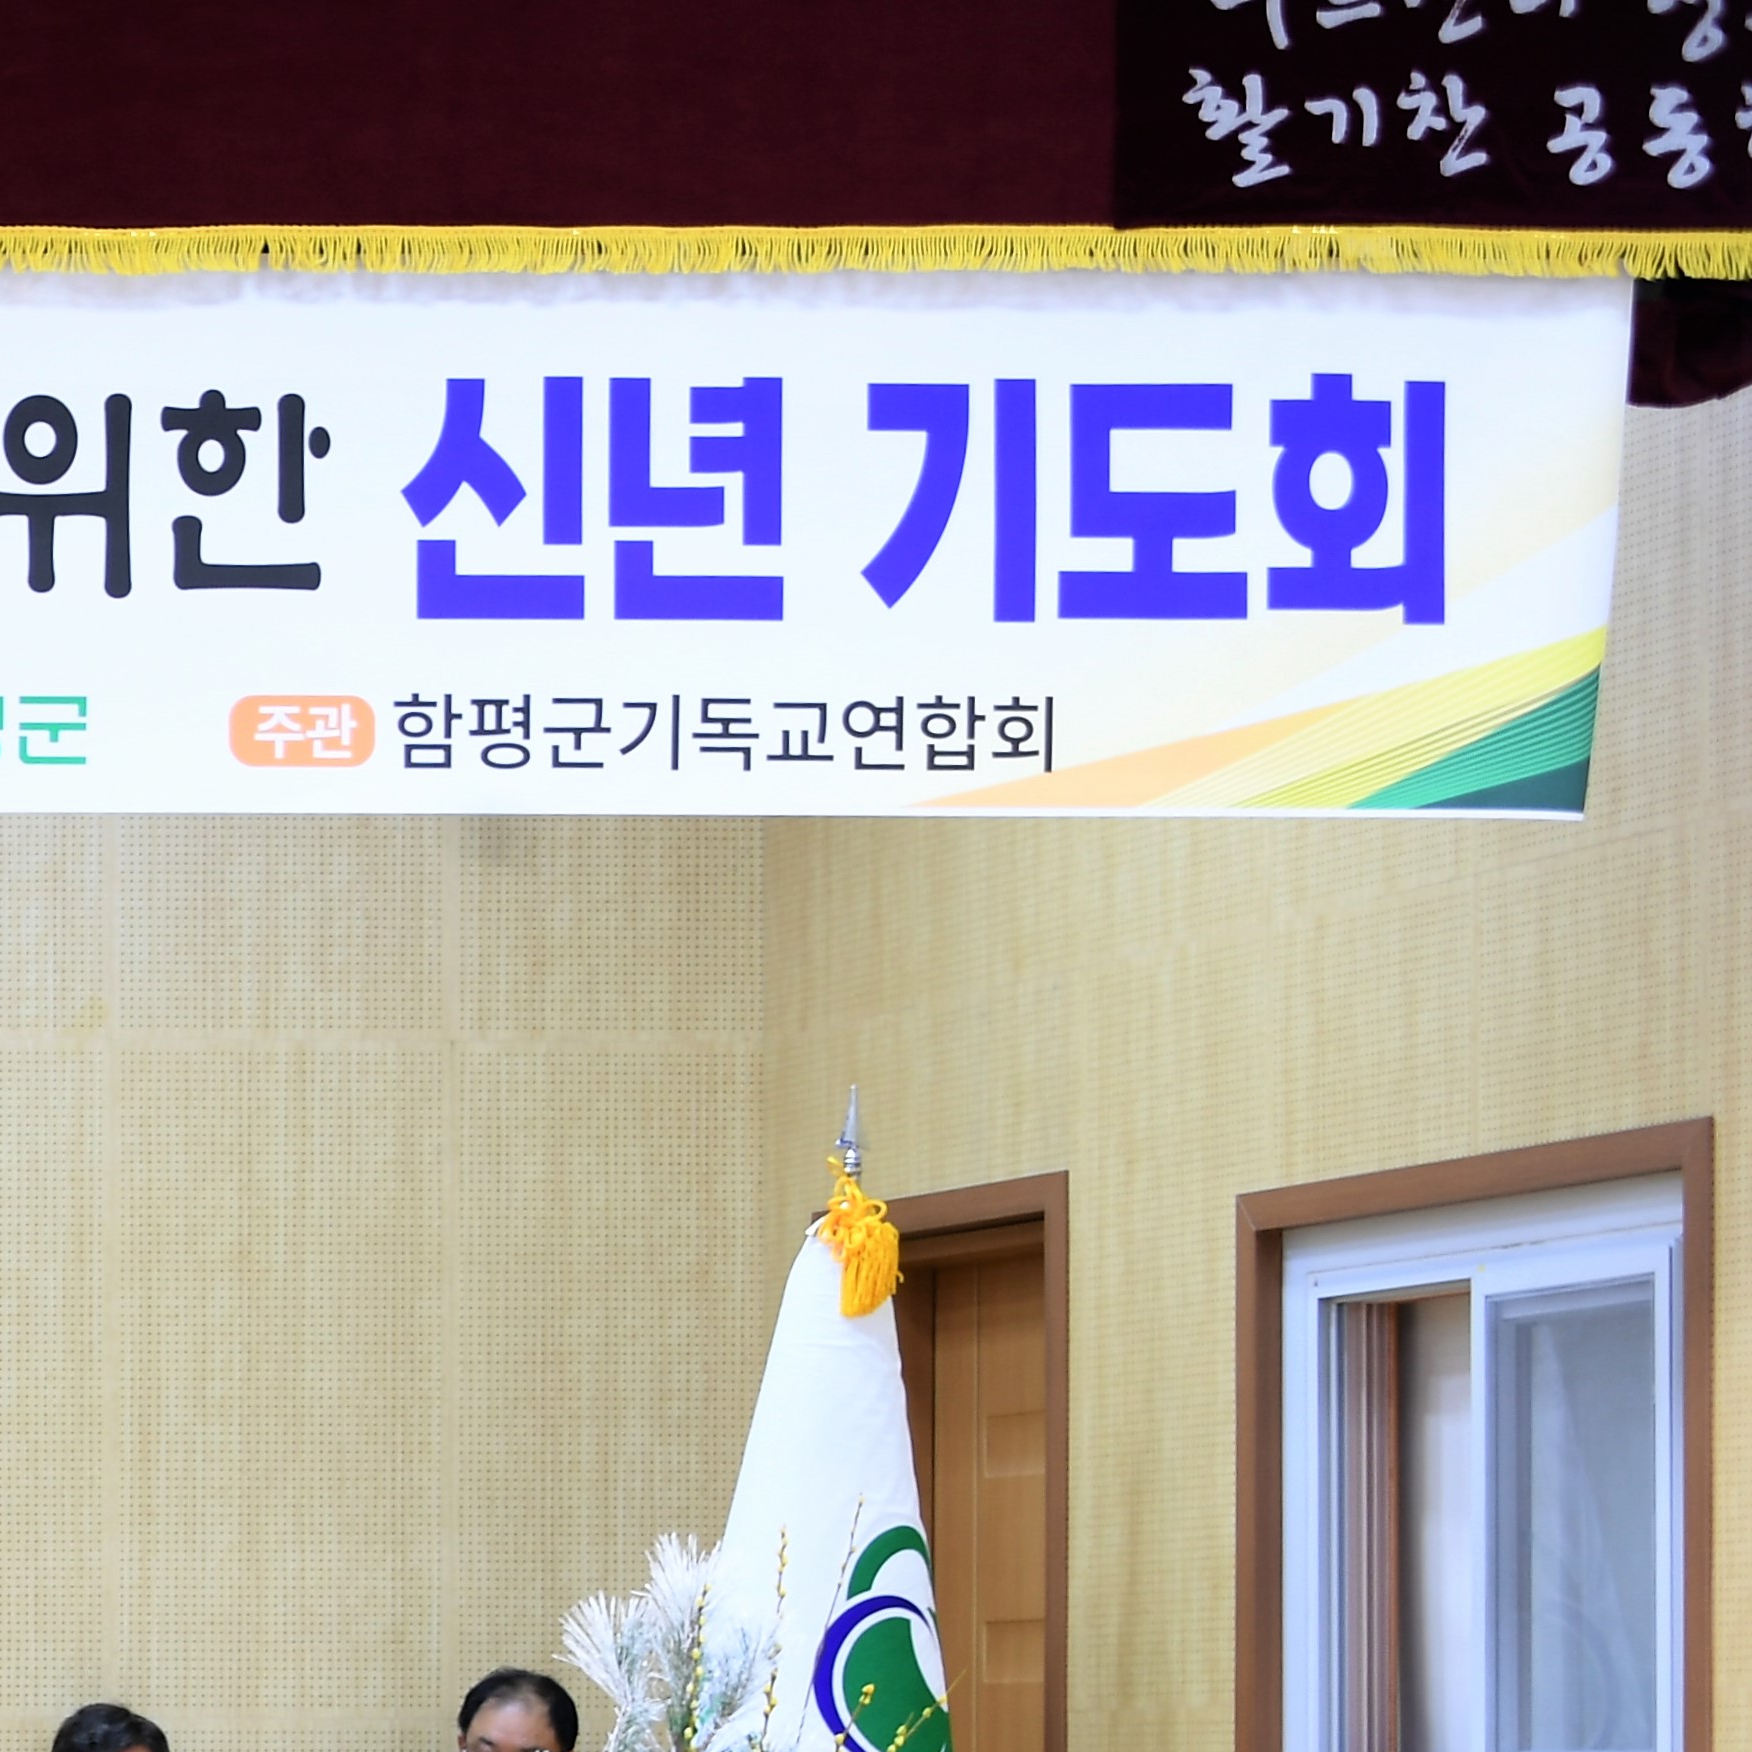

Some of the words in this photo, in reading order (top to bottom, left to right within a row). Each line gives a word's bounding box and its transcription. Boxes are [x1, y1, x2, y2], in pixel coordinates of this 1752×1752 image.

[1182, 68, 1489, 188] 활기찬
[1546, 84, 1752, 189] 공동
[401, 376, 784, 621] 신년
[861, 373, 1446, 625] 기도회
[252, 702, 358, 761] 주관
[393, 693, 1054, 773] 함평군기독교연합회
